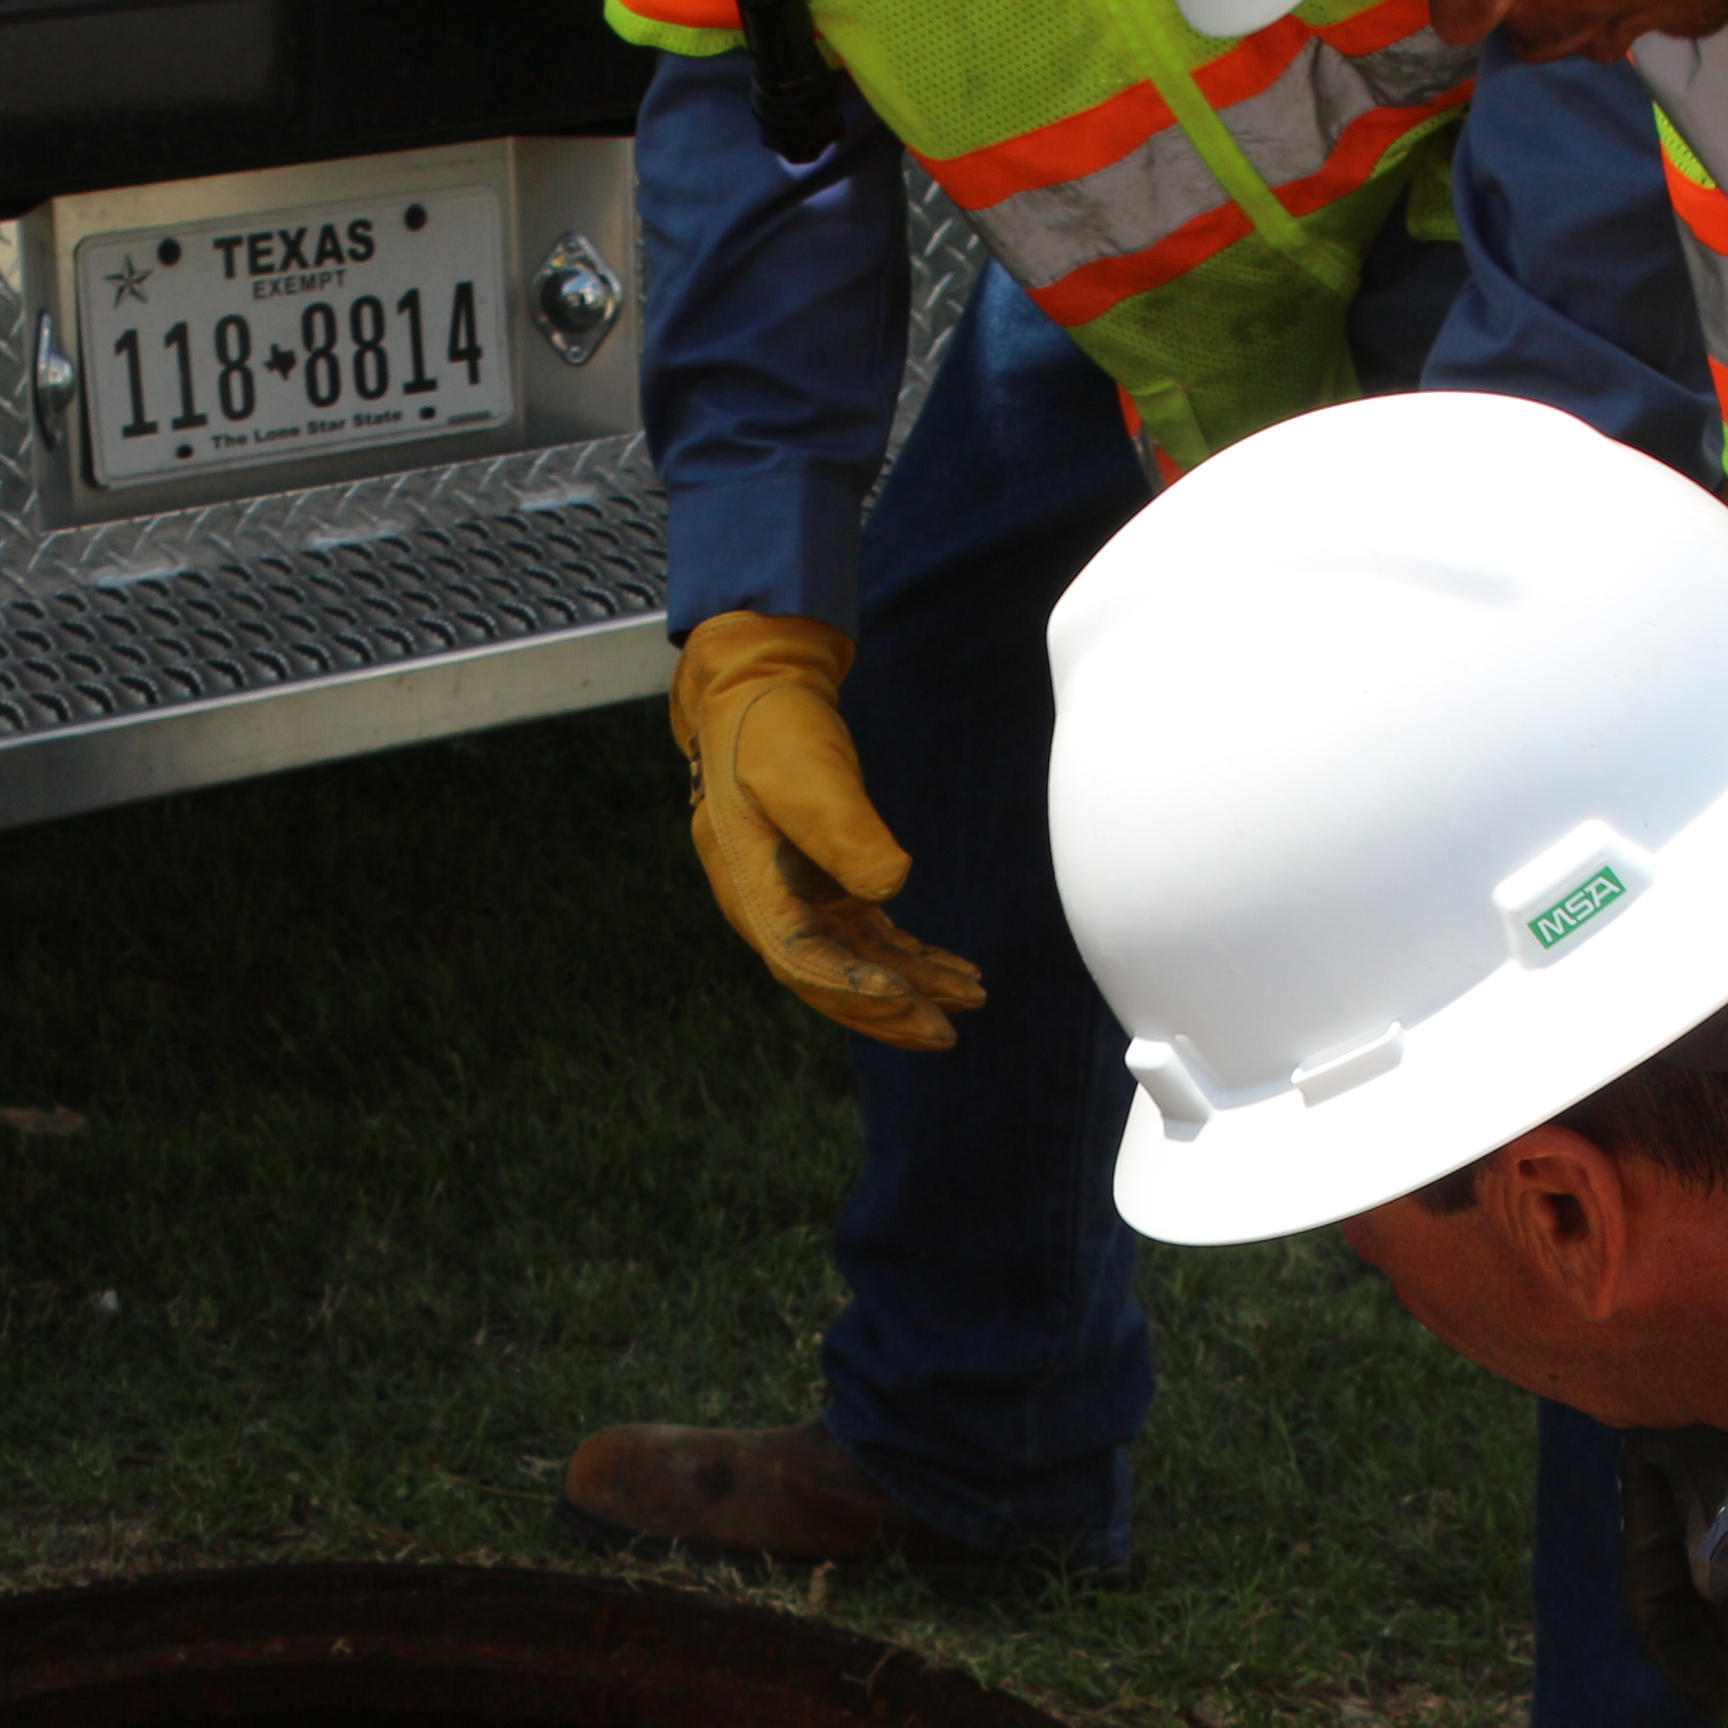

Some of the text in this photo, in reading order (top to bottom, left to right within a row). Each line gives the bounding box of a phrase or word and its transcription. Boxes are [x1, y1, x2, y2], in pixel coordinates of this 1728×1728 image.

[213, 217, 376, 280] TEXAS
[252, 268, 347, 300] EXEMPT
[211, 410, 403, 449] The Lone Star State
[1536, 875, 1622, 943] MSA
